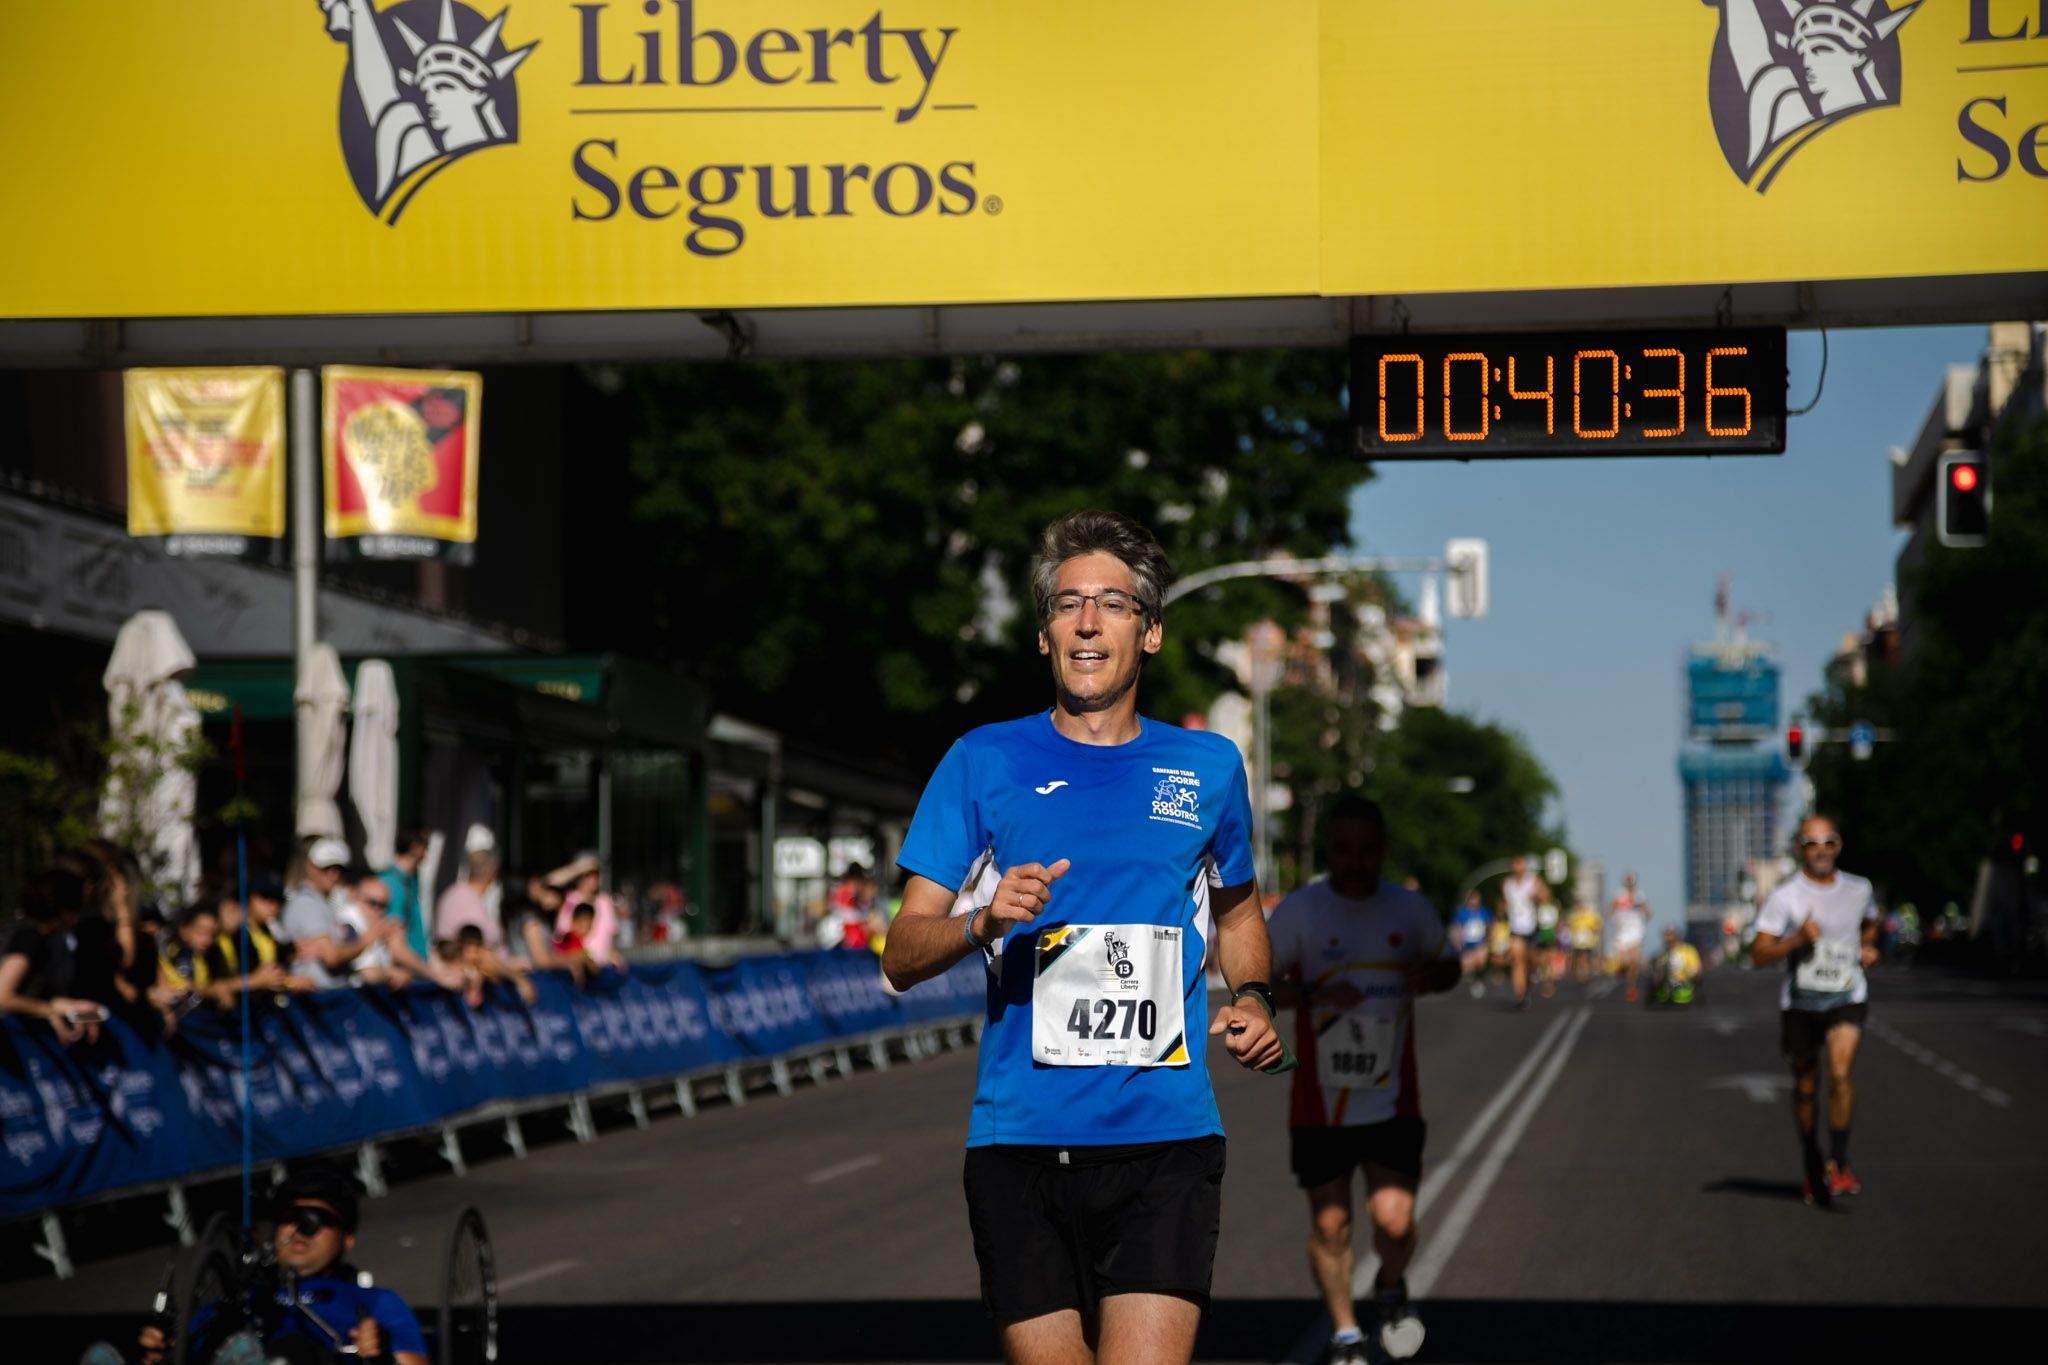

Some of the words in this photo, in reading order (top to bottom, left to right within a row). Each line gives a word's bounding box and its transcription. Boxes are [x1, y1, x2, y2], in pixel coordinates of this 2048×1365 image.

[572, 0, 961, 124] Liberty
[571, 138, 978, 257] Seguros
[1379, 347, 1752, 442] 00:40:36
[1168, 775, 1200, 787] CORRE
[1119, 964, 1131, 975] 13
[1067, 998, 1157, 1041] 4270
